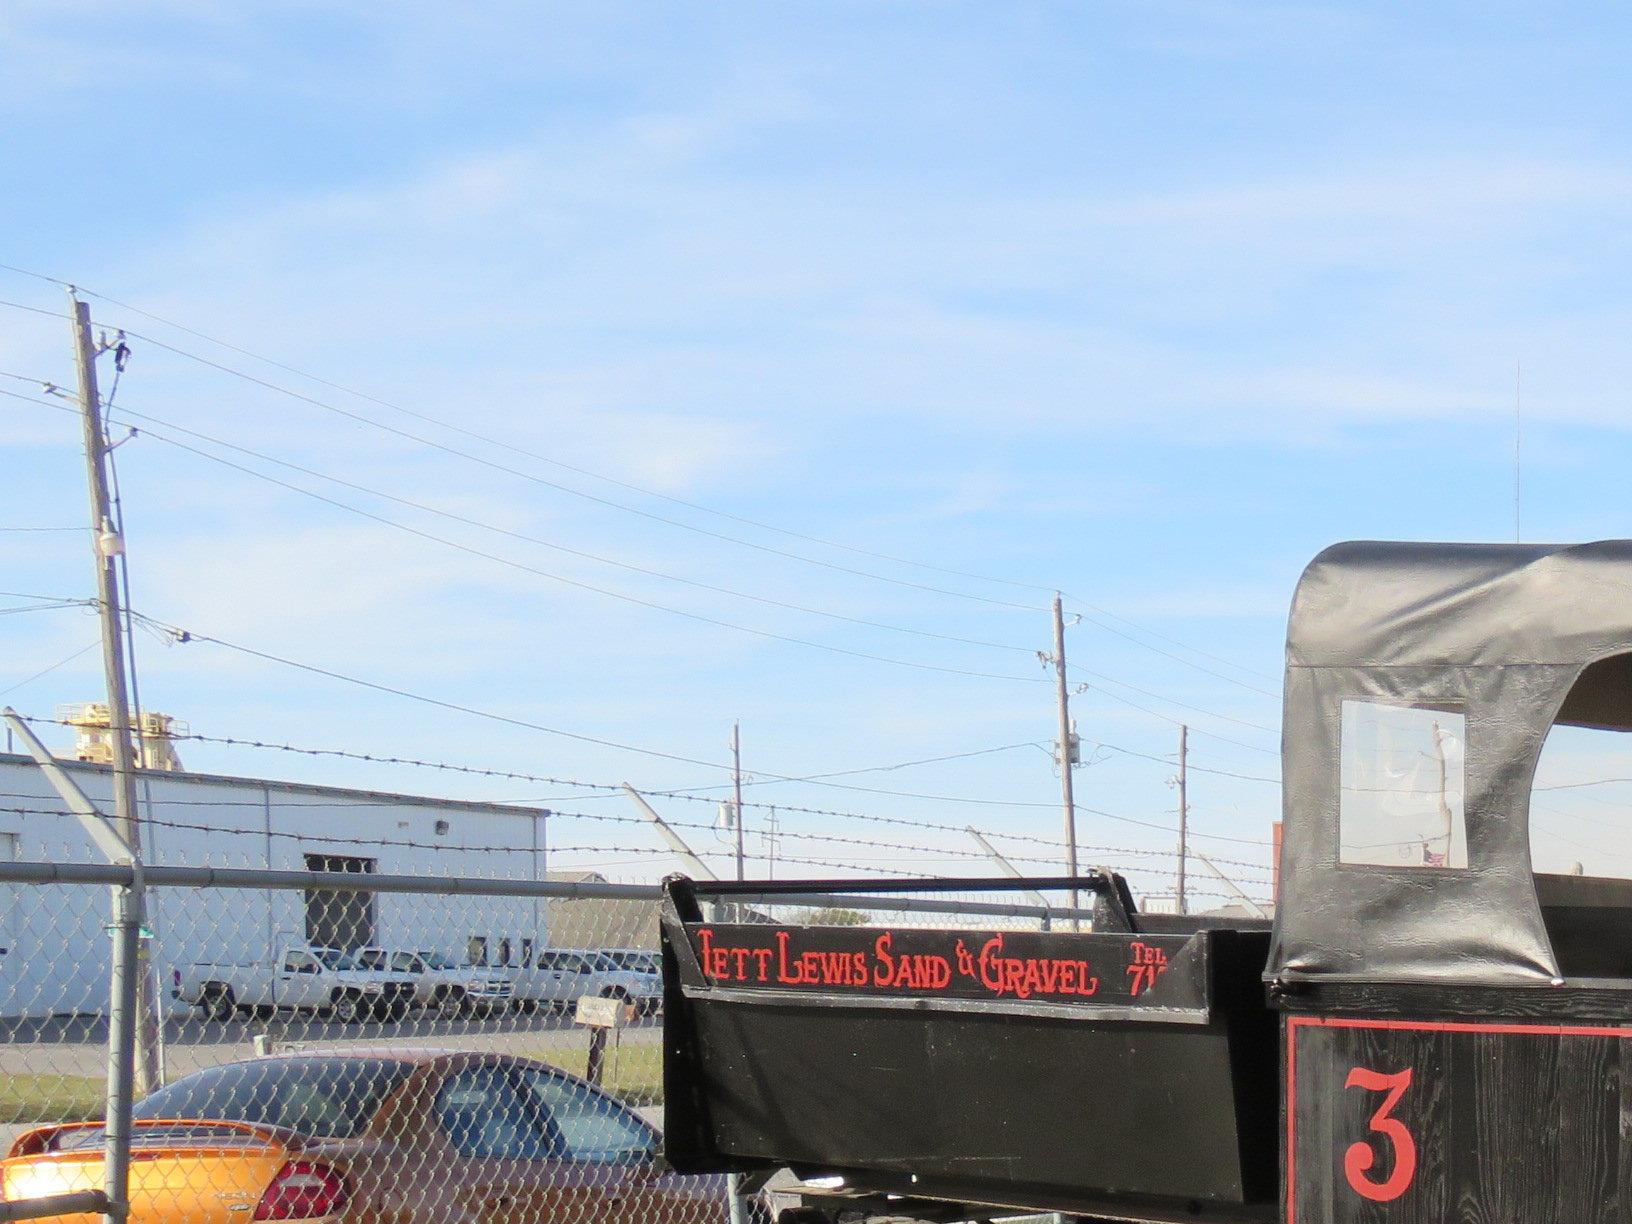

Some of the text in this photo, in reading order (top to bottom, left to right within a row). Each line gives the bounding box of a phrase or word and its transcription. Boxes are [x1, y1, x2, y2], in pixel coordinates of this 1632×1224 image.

[776, 931, 868, 986] LEWIS
[874, 931, 951, 989] SAND
[956, 938, 977, 980] &
[979, 932, 1098, 998] GRAVEL
[1343, 1066, 1416, 1202] 3
